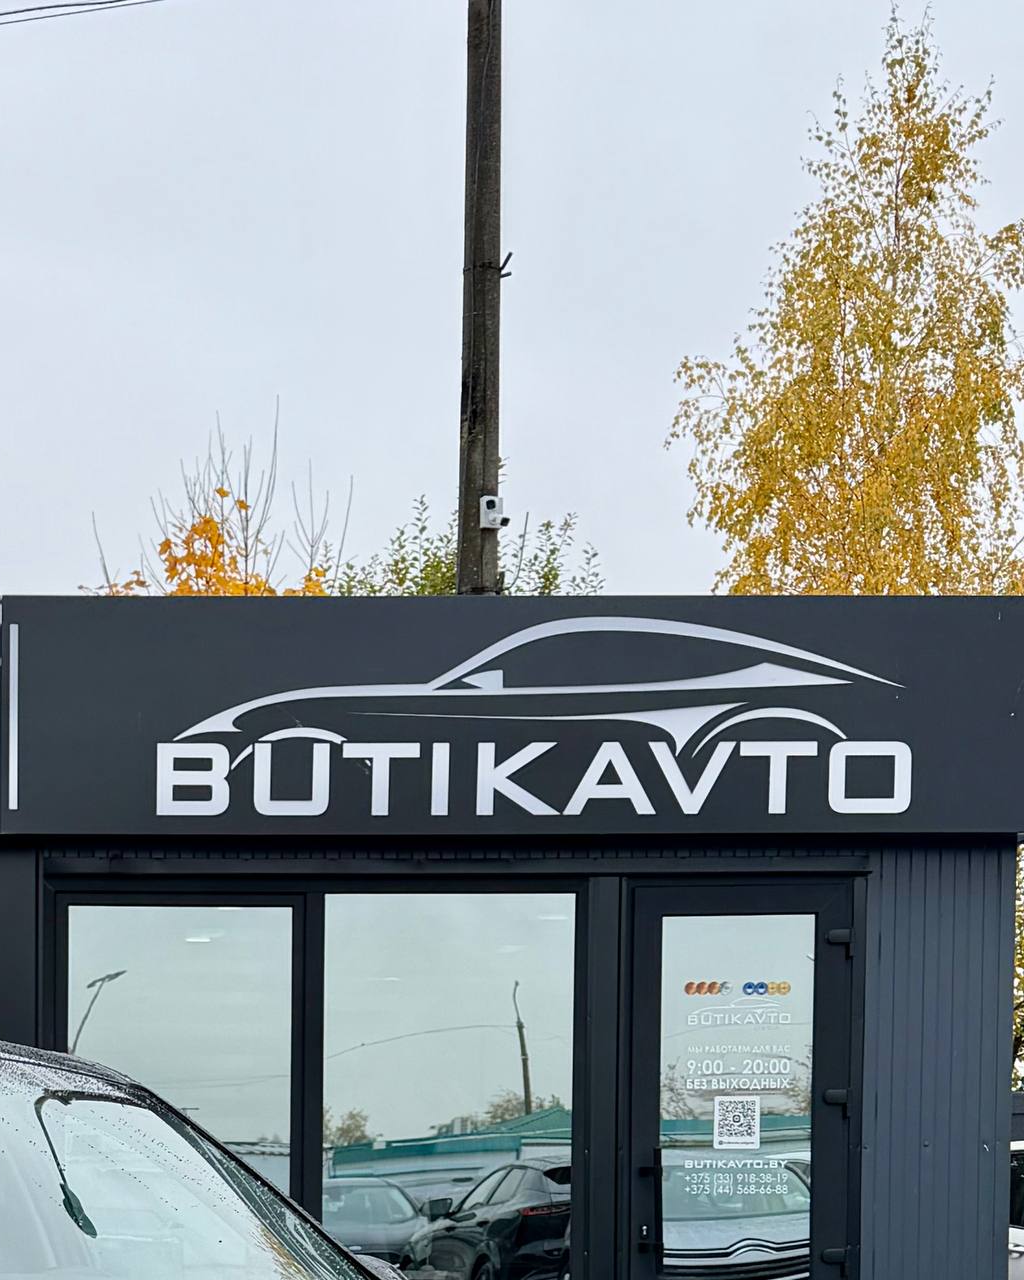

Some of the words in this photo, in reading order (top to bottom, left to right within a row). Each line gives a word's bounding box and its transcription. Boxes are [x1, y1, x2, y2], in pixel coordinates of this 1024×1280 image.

[156, 740, 912, 816] BUTIKAVTO
[687, 1013, 791, 1025] BUTIKAVTO
[687, 1060, 724, 1075] 9:00
[742, 1059, 790, 1074] 20:00
[686, 1079, 707, 1089] БЕЗ
[711, 1078, 790, 1090] ВЫХОДНЫХ
[684, 1160, 788, 1169] BUTIKAVTO.BY
[684, 1173, 710, 1184] +375
[713, 1173, 733, 1185] (33)
[736, 1173, 788, 1184] 918-38-19
[684, 1185, 710, 1195] +375
[713, 1184, 733, 1196] (44)
[736, 1184, 788, 1195] 568-66-88
